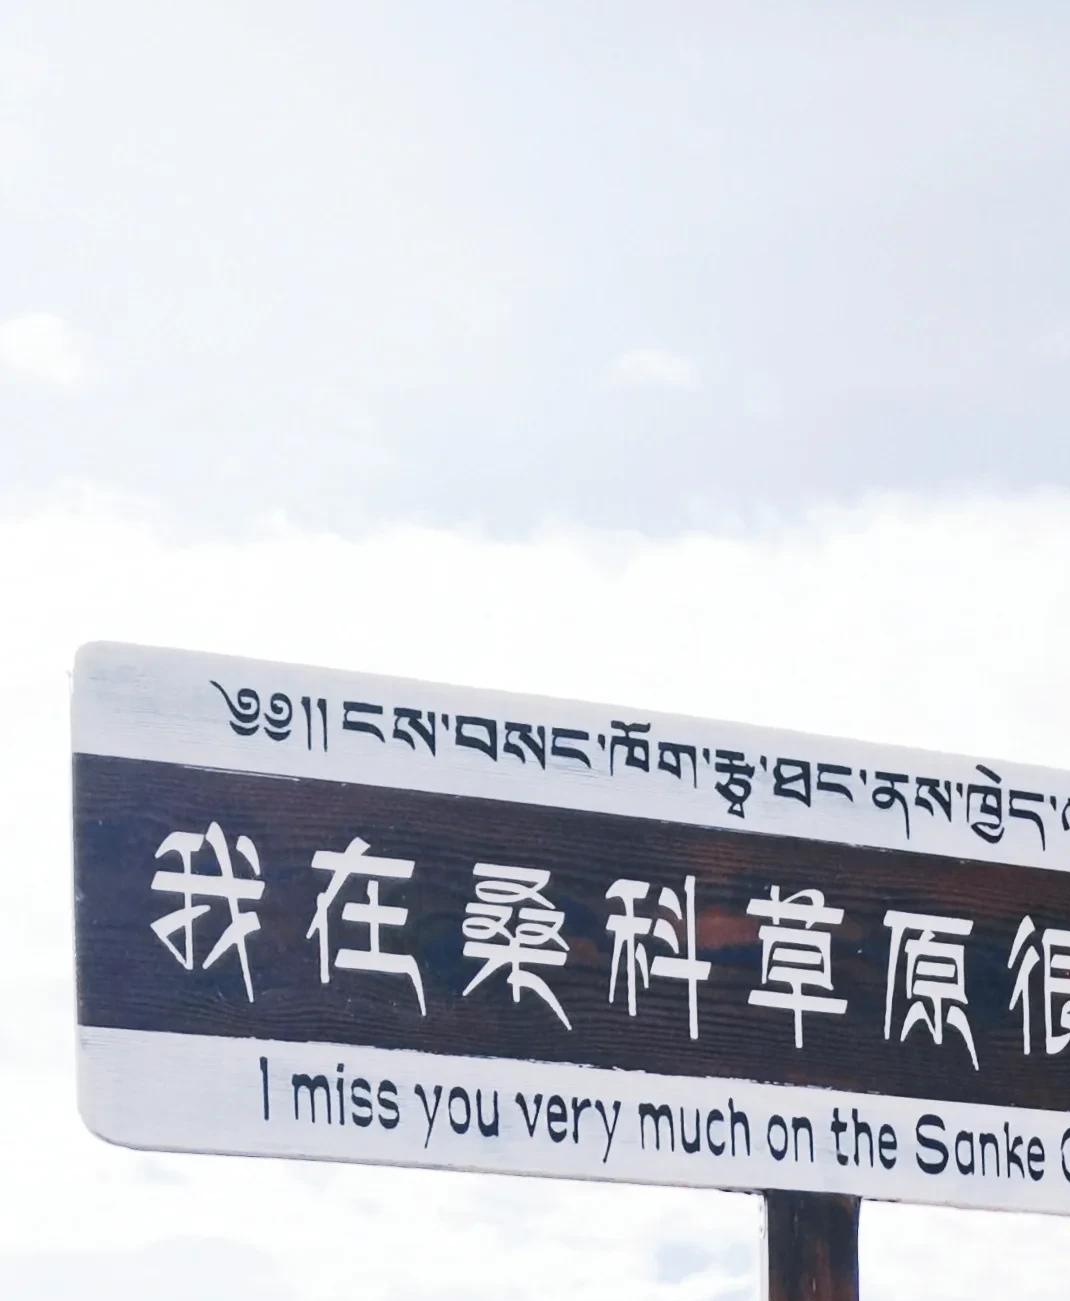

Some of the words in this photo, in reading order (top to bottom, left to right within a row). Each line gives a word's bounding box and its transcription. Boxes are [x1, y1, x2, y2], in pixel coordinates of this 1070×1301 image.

[259, 1056, 270, 1121] I
[291, 1062, 400, 1129] miss
[414, 1084, 500, 1149] you
[515, 1091, 622, 1163] very
[638, 1097, 750, 1157] much
[767, 1114, 814, 1163] on
[830, 1107, 898, 1170] the
[915, 1113, 1046, 1181] Sanke
